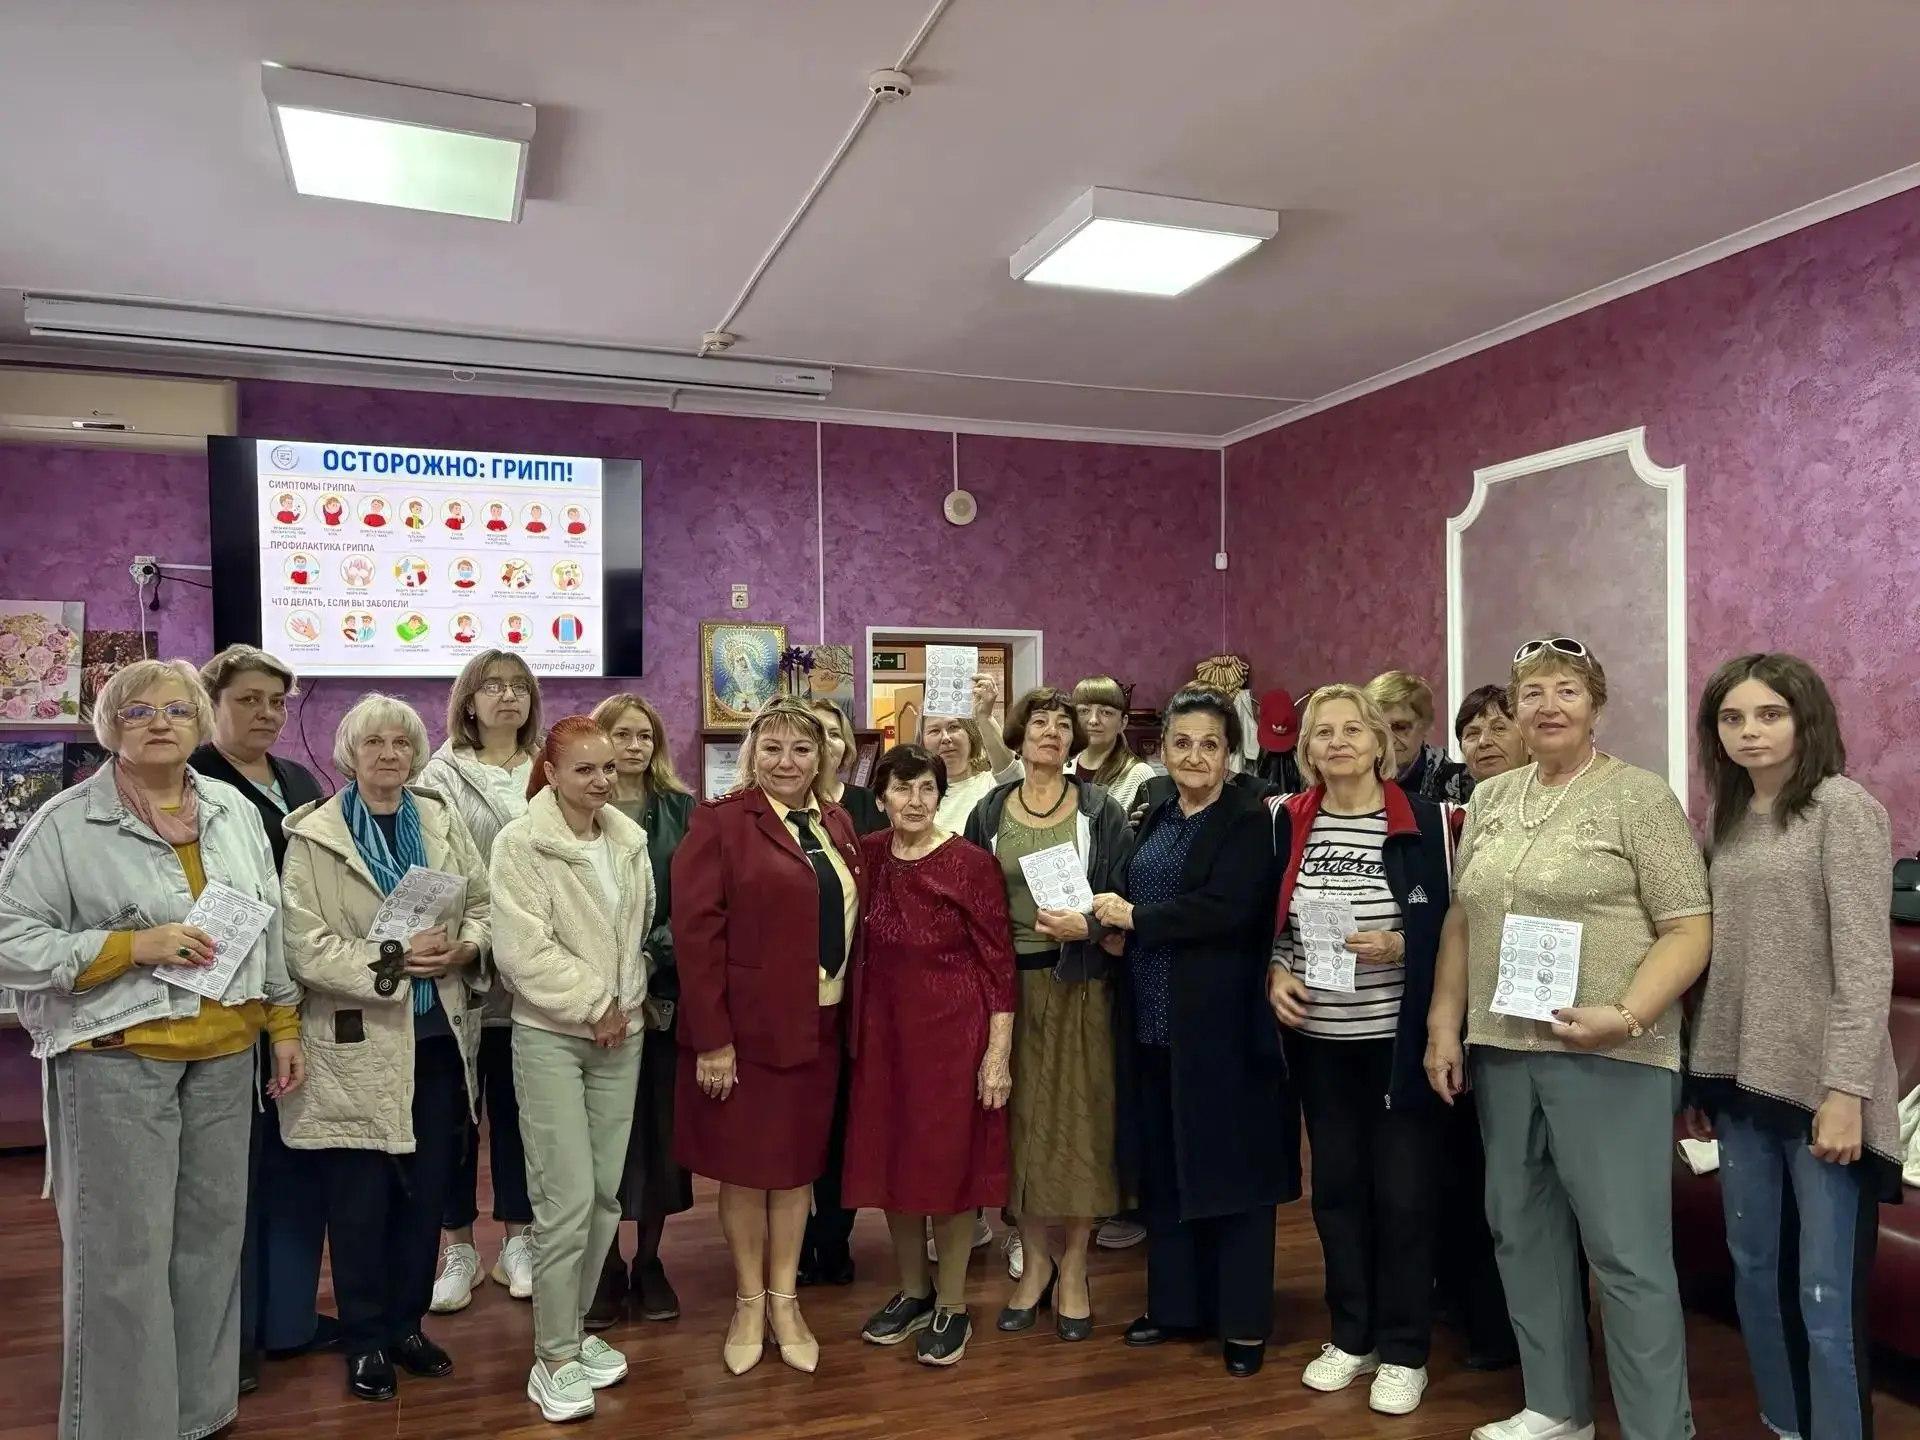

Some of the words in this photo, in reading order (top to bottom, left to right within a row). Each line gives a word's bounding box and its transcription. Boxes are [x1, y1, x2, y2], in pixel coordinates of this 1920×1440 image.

[323, 449, 485, 478] ОСТОРОЖНО:
[492, 458, 573, 482] ГРИПП!
[269, 480, 321, 491] СИМПТОМЫ
[322, 482, 356, 492] ГРИППА
[270, 541, 341, 551] ПРОФИЛАКТИКА
[342, 543, 375, 552] ГРИППА
[272, 597, 289, 606] ЧТО
[290, 598, 326, 608] ДЕЛАТЬ,
[327, 599, 350, 607] ЕСЛИ
[352, 599, 365, 607] ВЫ
[366, 600, 409, 608] ЗАБОЛЕЛИ
[529, 660, 596, 673] потребнадзор
